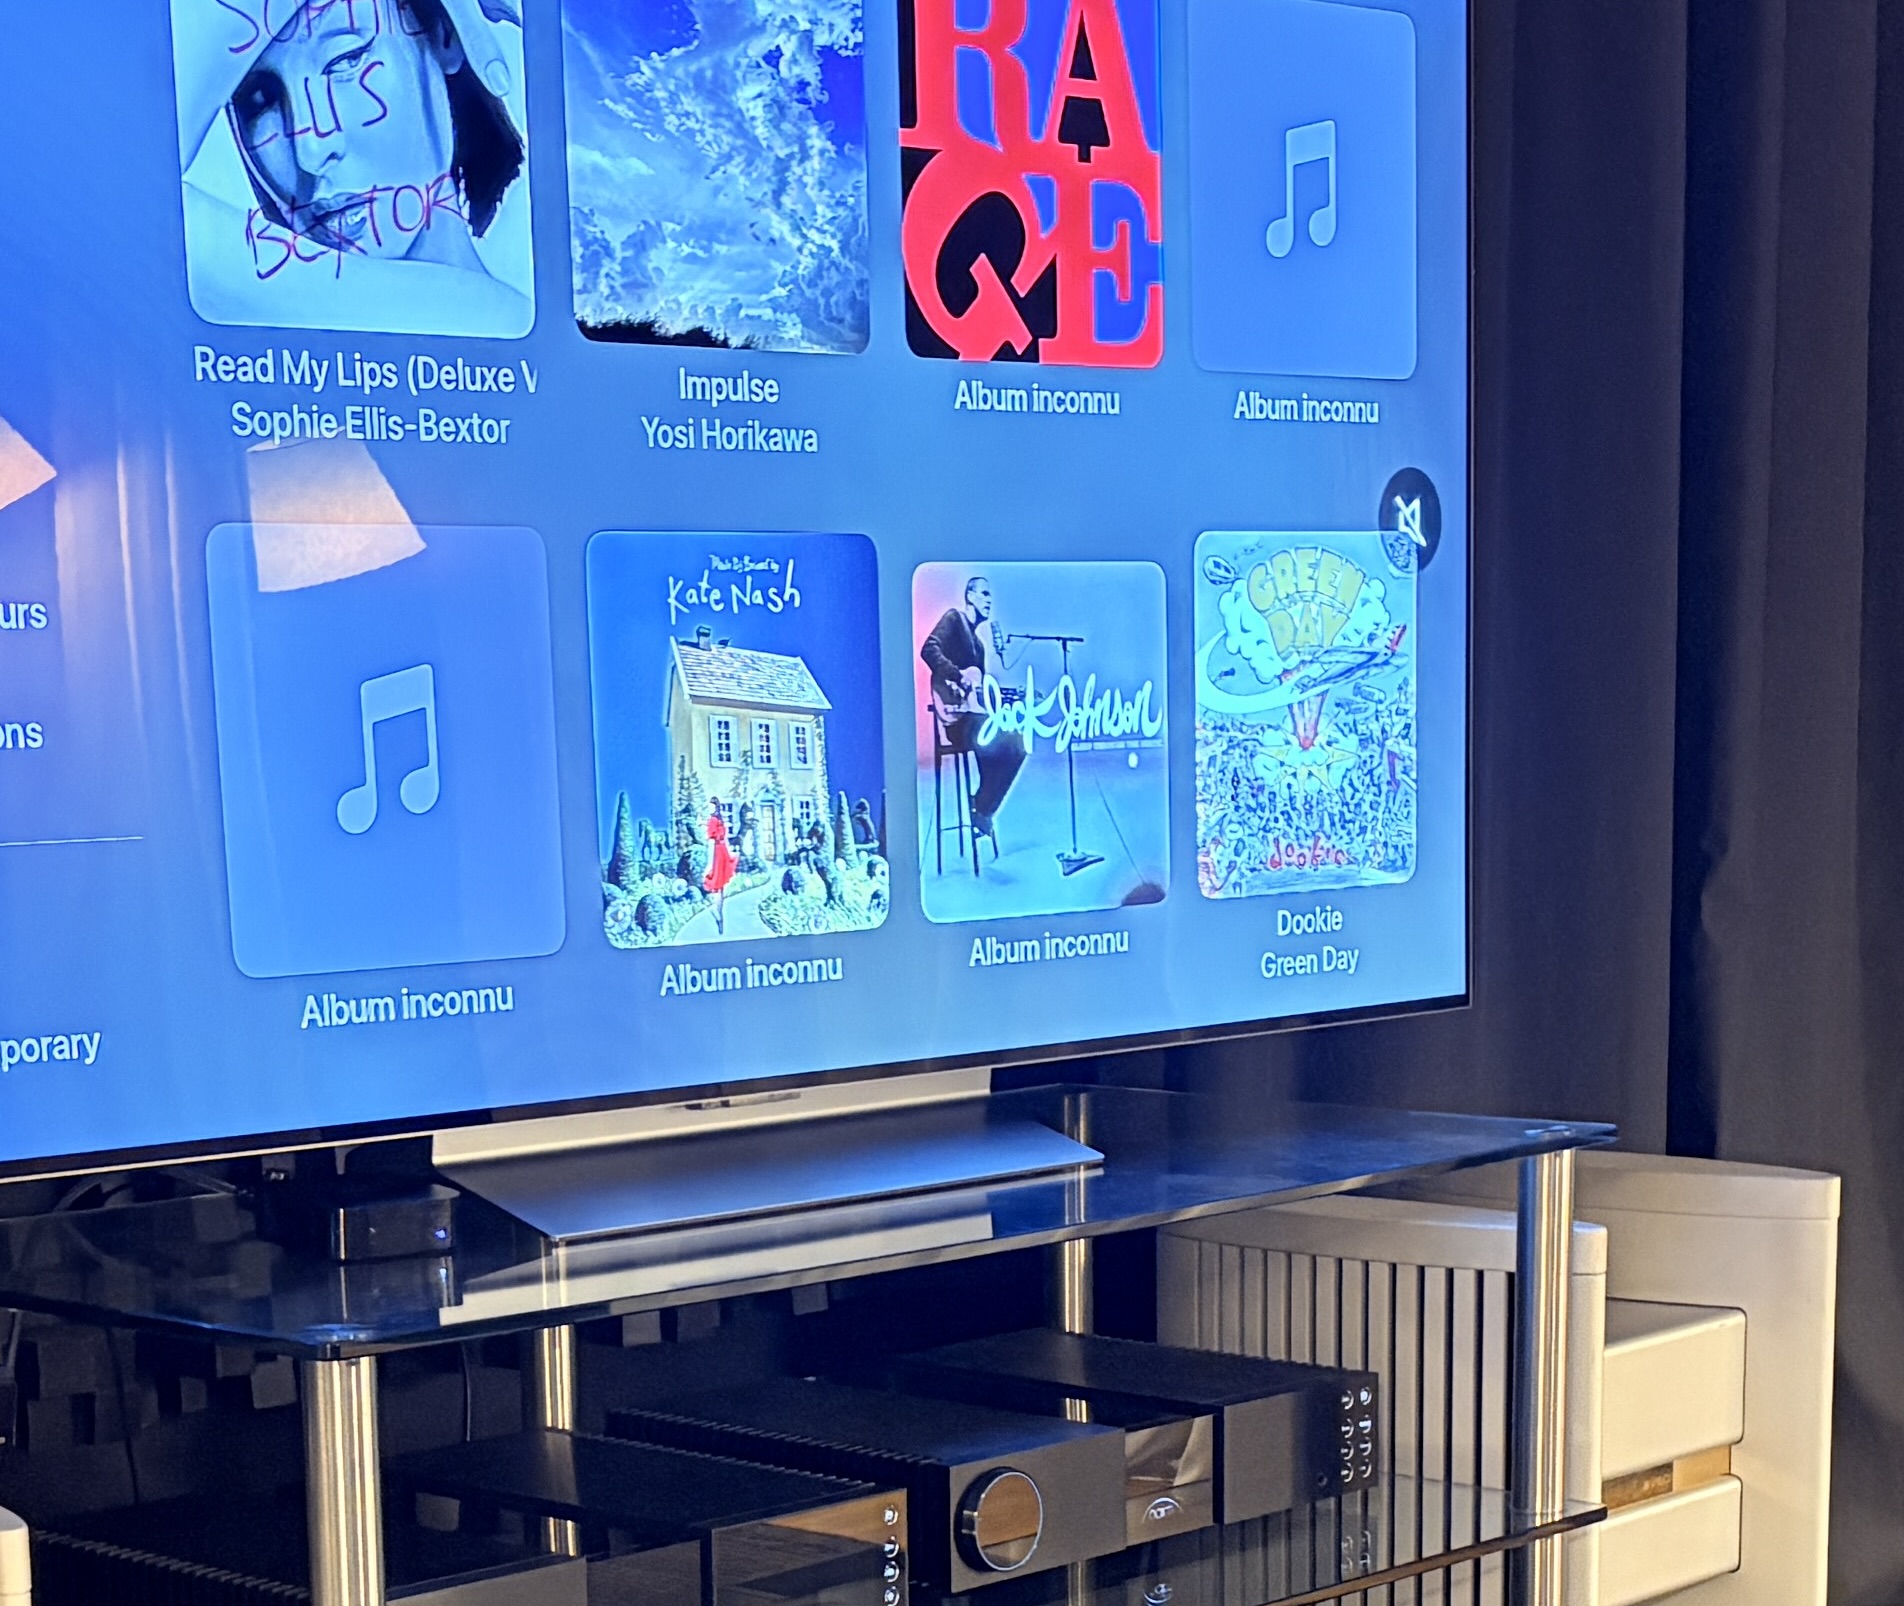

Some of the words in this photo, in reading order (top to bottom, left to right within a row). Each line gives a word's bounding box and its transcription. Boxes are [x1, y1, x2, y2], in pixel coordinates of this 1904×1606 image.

[194, 345, 275, 383] Read
[282, 349, 329, 393] My
[336, 351, 398, 395] Lips
[407, 354, 516, 396] (Deluxe
[679, 367, 779, 408] Impulse
[954, 380, 1028, 412] Album
[1032, 382, 1120, 415] inconnu
[1233, 390, 1299, 420] Album
[1302, 392, 1379, 423] inconnu
[231, 401, 338, 446] Sophie
[345, 405, 511, 444] Ellis-Bextor
[640, 416, 696, 449] Yosi
[701, 418, 818, 452] Horikawa
[667, 568, 725, 625] Kate
[731, 558, 802, 614] Nash
[1247, 546, 1366, 613] GREEN
[1266, 602, 1350, 662] DAY
[977, 665, 1064, 754] Jack
[1055, 672, 1163, 754] Johnson
[1277, 905, 1343, 936] Dookie
[969, 936, 1041, 967] Album
[1044, 931, 1129, 960] inconnu
[1260, 952, 1318, 978] Green
[1322, 945, 1359, 974] Day
[660, 963, 742, 997] Album
[745, 957, 843, 990] inconnu
[300, 993, 396, 1029] Album
[400, 986, 514, 1020] inconnu
